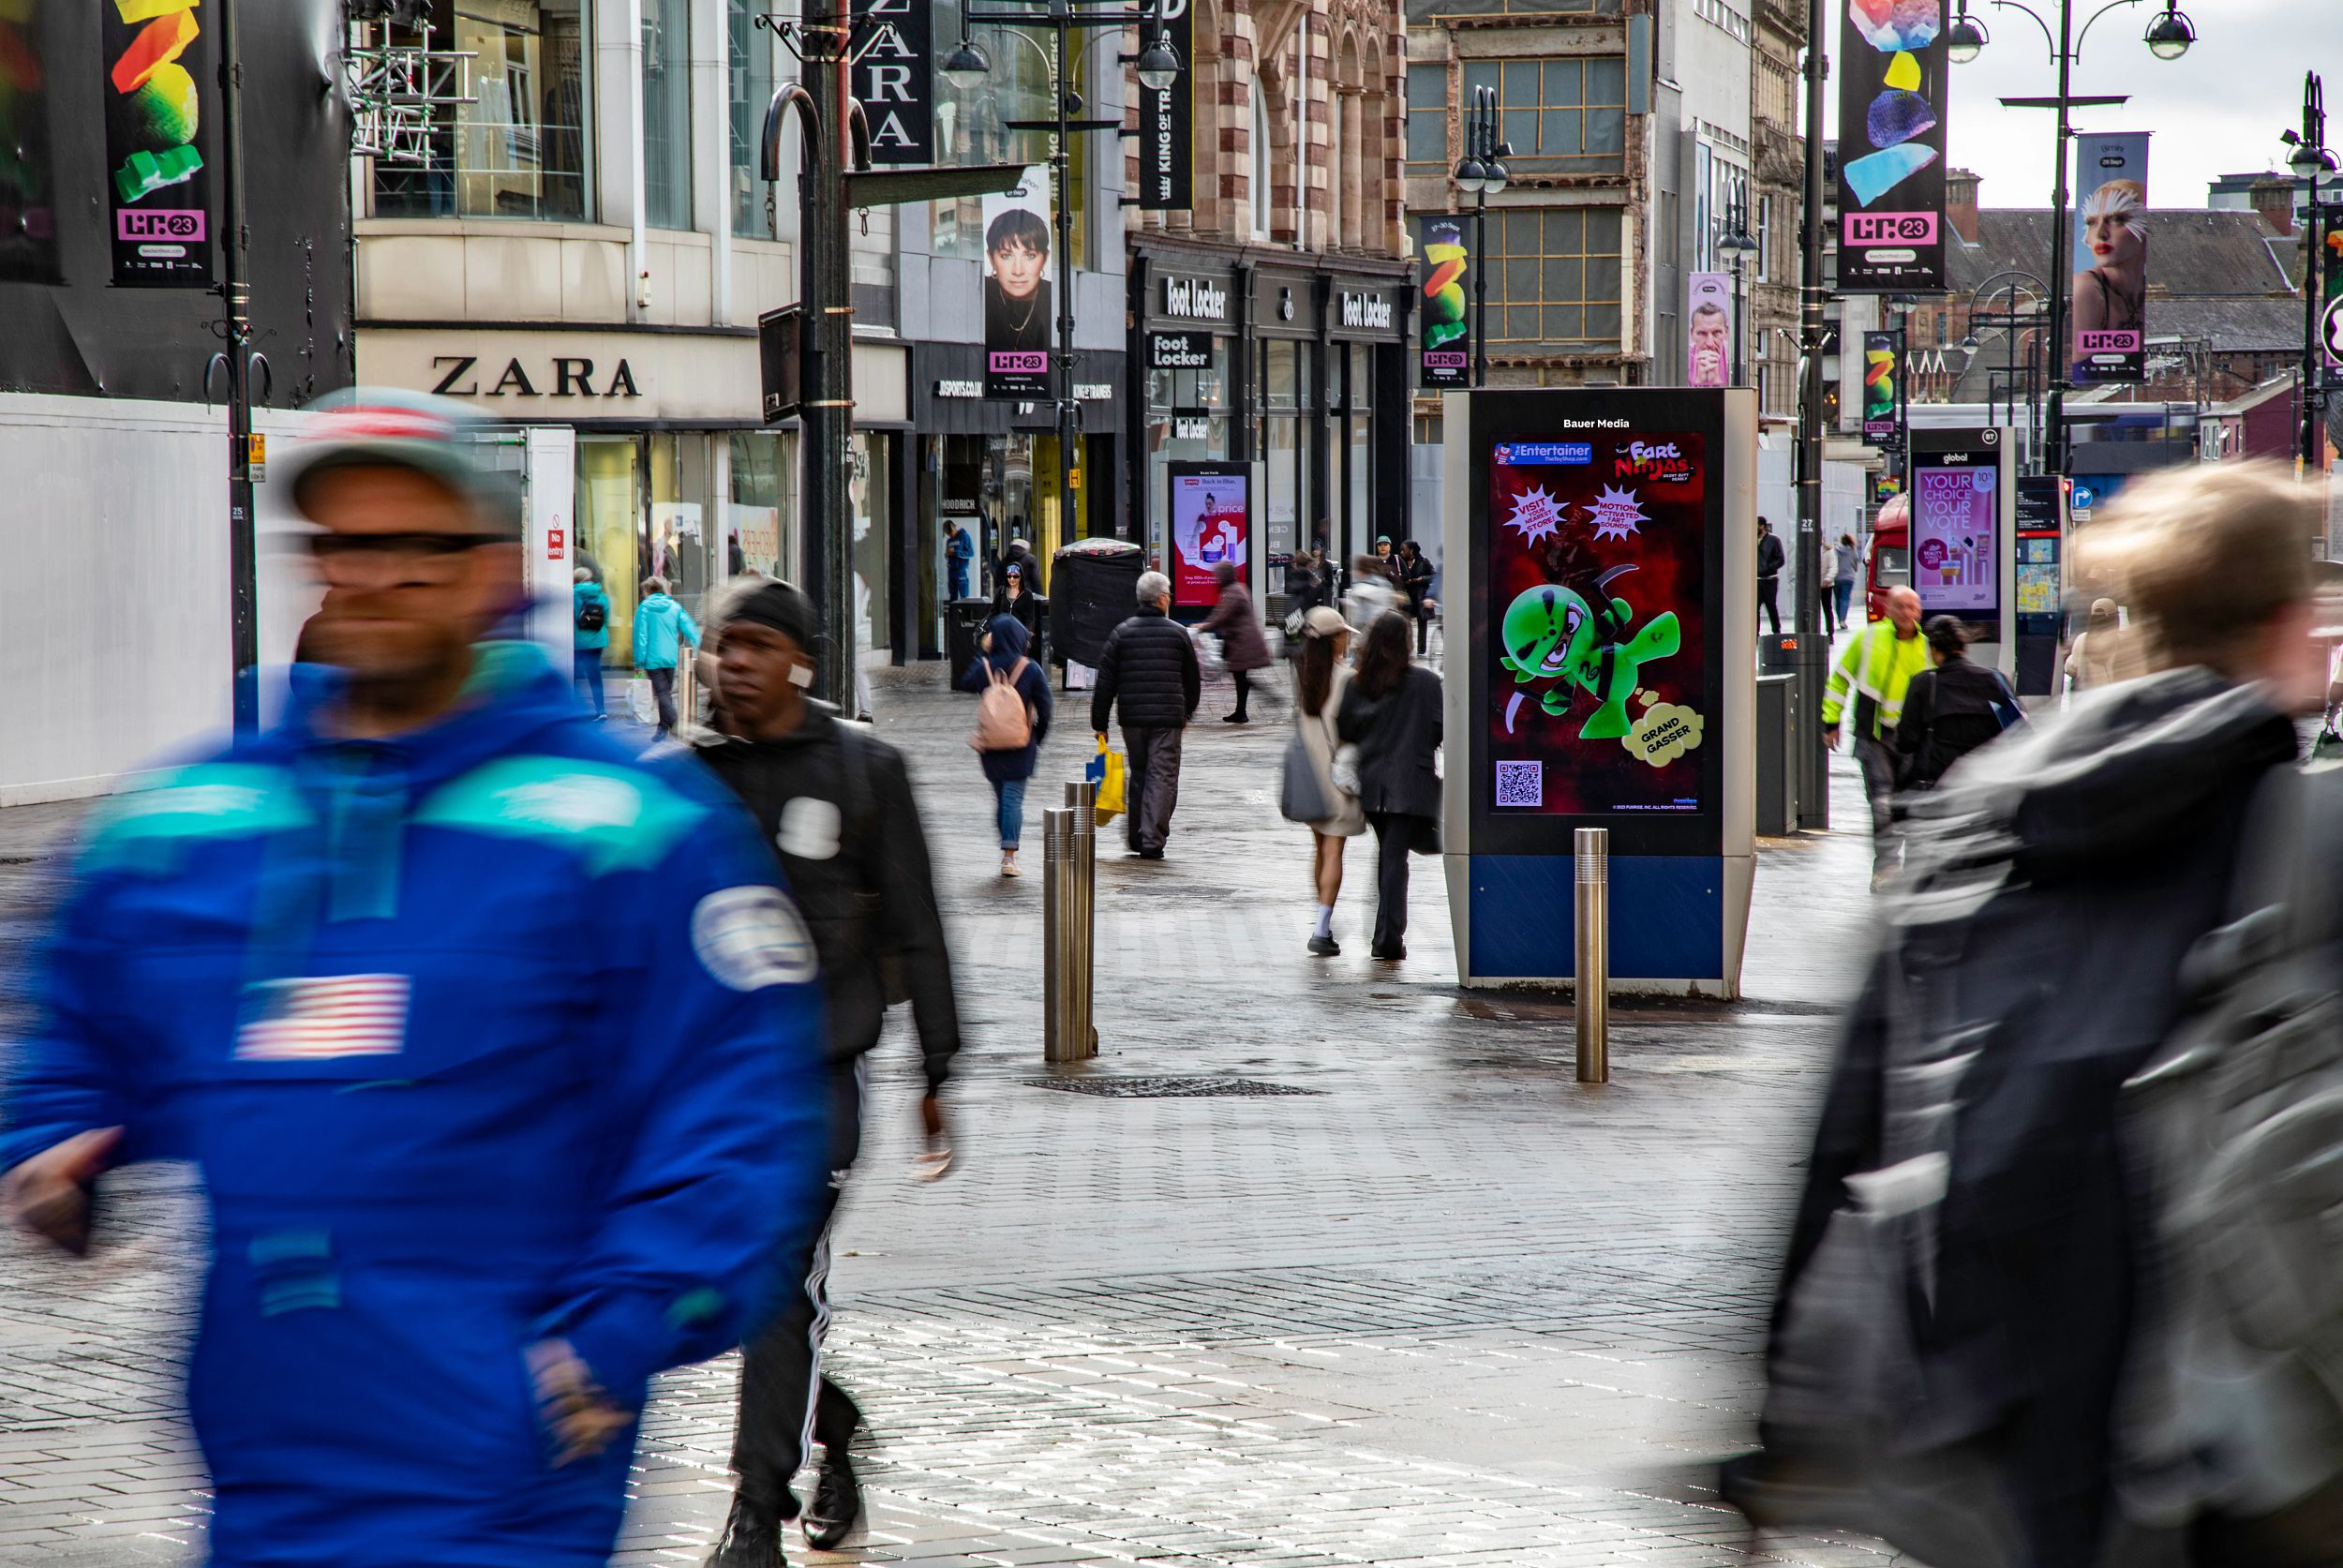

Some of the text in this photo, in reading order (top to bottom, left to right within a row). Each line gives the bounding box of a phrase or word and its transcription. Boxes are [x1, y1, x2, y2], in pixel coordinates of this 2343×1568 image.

[1158, 113, 1171, 130] OF
[1158, 131, 1171, 172] KING
[172, 217, 193, 232] 23
[1903, 220, 1924, 236] 23
[1167, 276, 1226, 320] Foot Locker
[1343, 291, 1392, 328] Foot Locker
[1154, 336, 1189, 351] Foot
[2116, 336, 2131, 346] 23
[1025, 357, 1040, 367] 23
[1154, 351, 1207, 366] Locker
[431, 356, 643, 397] ZARA
[1176, 418, 1207, 441] Foot Locker
[1563, 419, 1630, 428] Bauer Media
[1520, 444, 1590, 456] Entertainer
[1630, 441, 1681, 460] Fart
[1943, 453, 1968, 465] global
[1614, 456, 1689, 481] Ninjas
[1070, 470, 1079, 486] H
[1924, 475, 1972, 489] YOUR
[1924, 490, 1972, 500] CHOICE
[232, 507, 243, 515] 25
[1218, 503, 1245, 515] price
[1517, 497, 1546, 515] VISIT
[1528, 507, 1545, 517] YOUR
[1599, 501, 1637, 512] MOTION
[1924, 500, 1972, 515] YOUR
[1525, 510, 1552, 525] NEAREST
[1597, 510, 1640, 519] ACTIVATED
[1526, 515, 1556, 532] STORE!
[1600, 521, 1632, 530] SOUNDS!
[1802, 519, 1813, 528] 27
[1924, 515, 1972, 530] VOTE
[551, 533, 561, 543] No
[548, 547, 562, 558] entry
[1641, 717, 1679, 742] GRAND
[1647, 724, 1691, 754] GASSER
